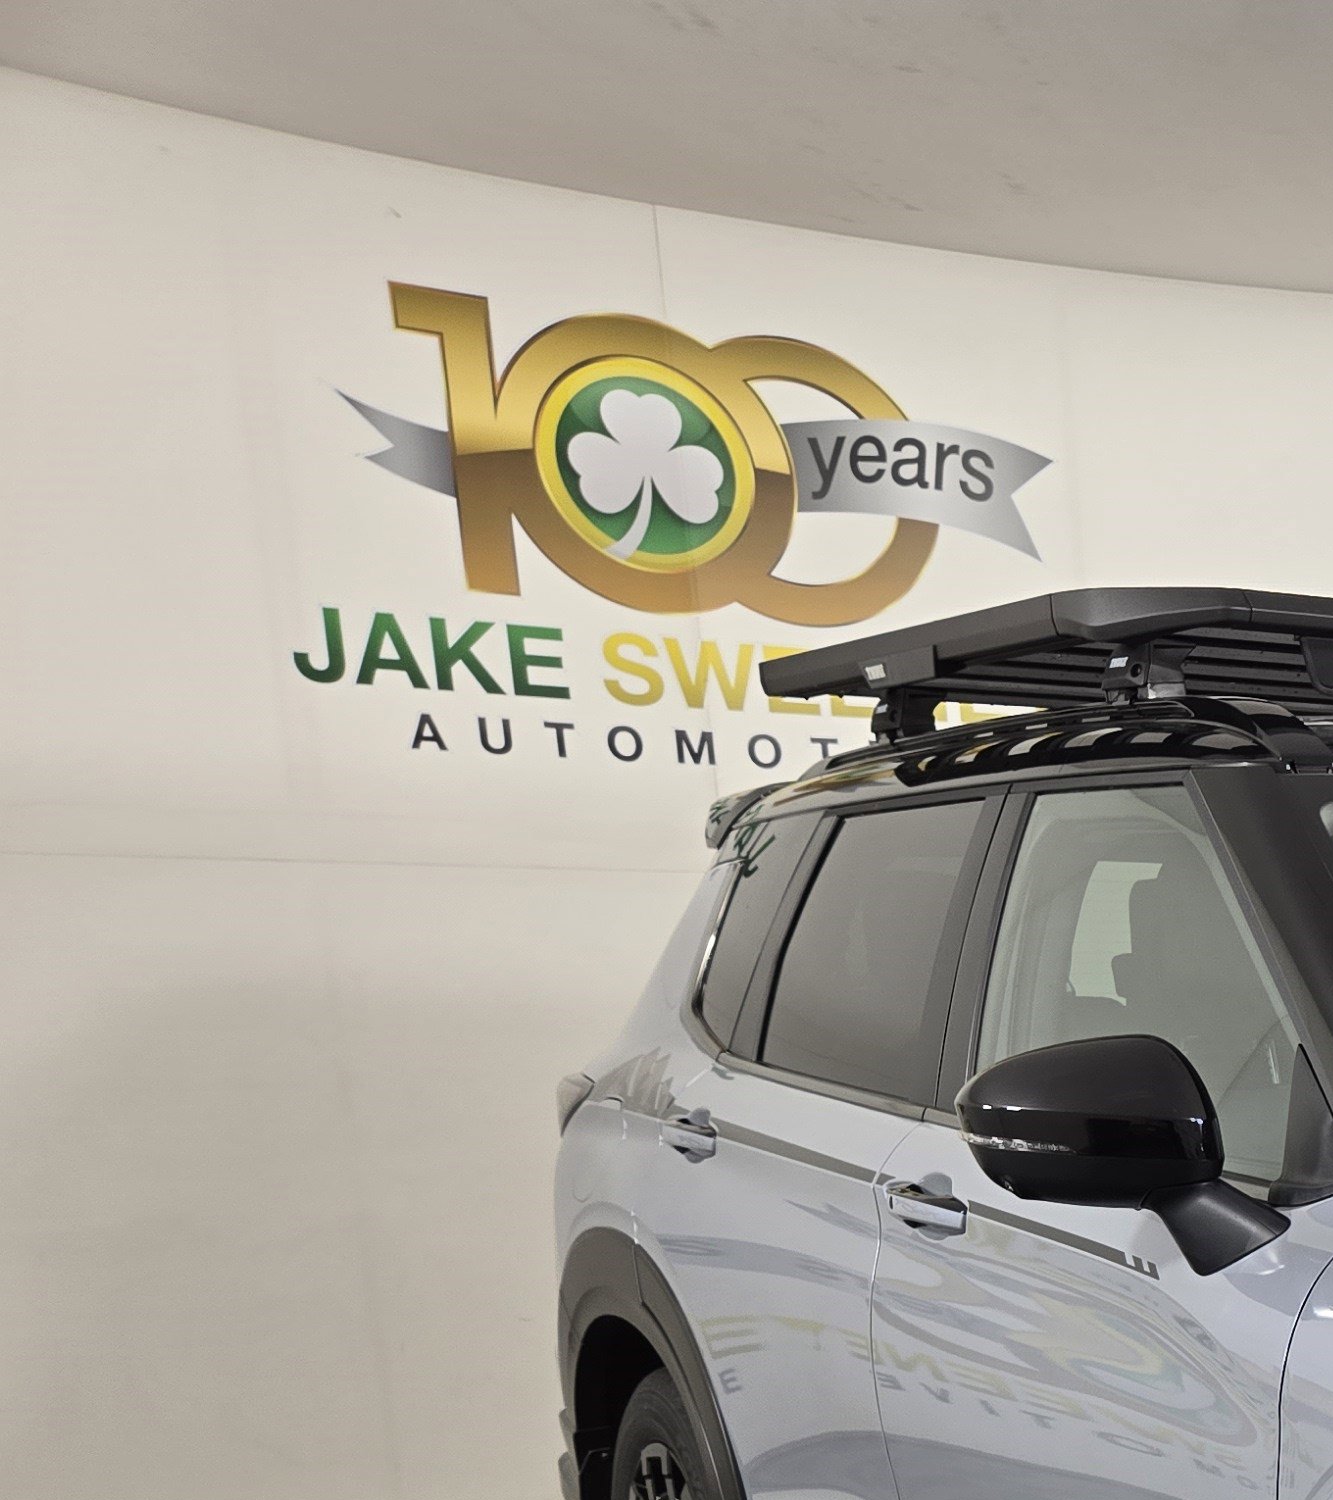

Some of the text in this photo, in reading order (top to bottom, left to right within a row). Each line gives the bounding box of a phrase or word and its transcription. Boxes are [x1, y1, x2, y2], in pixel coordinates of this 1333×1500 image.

[806, 433, 996, 503] years
[292, 606, 572, 701] JAKE
[411, 712, 839, 770] AUTOMOT
